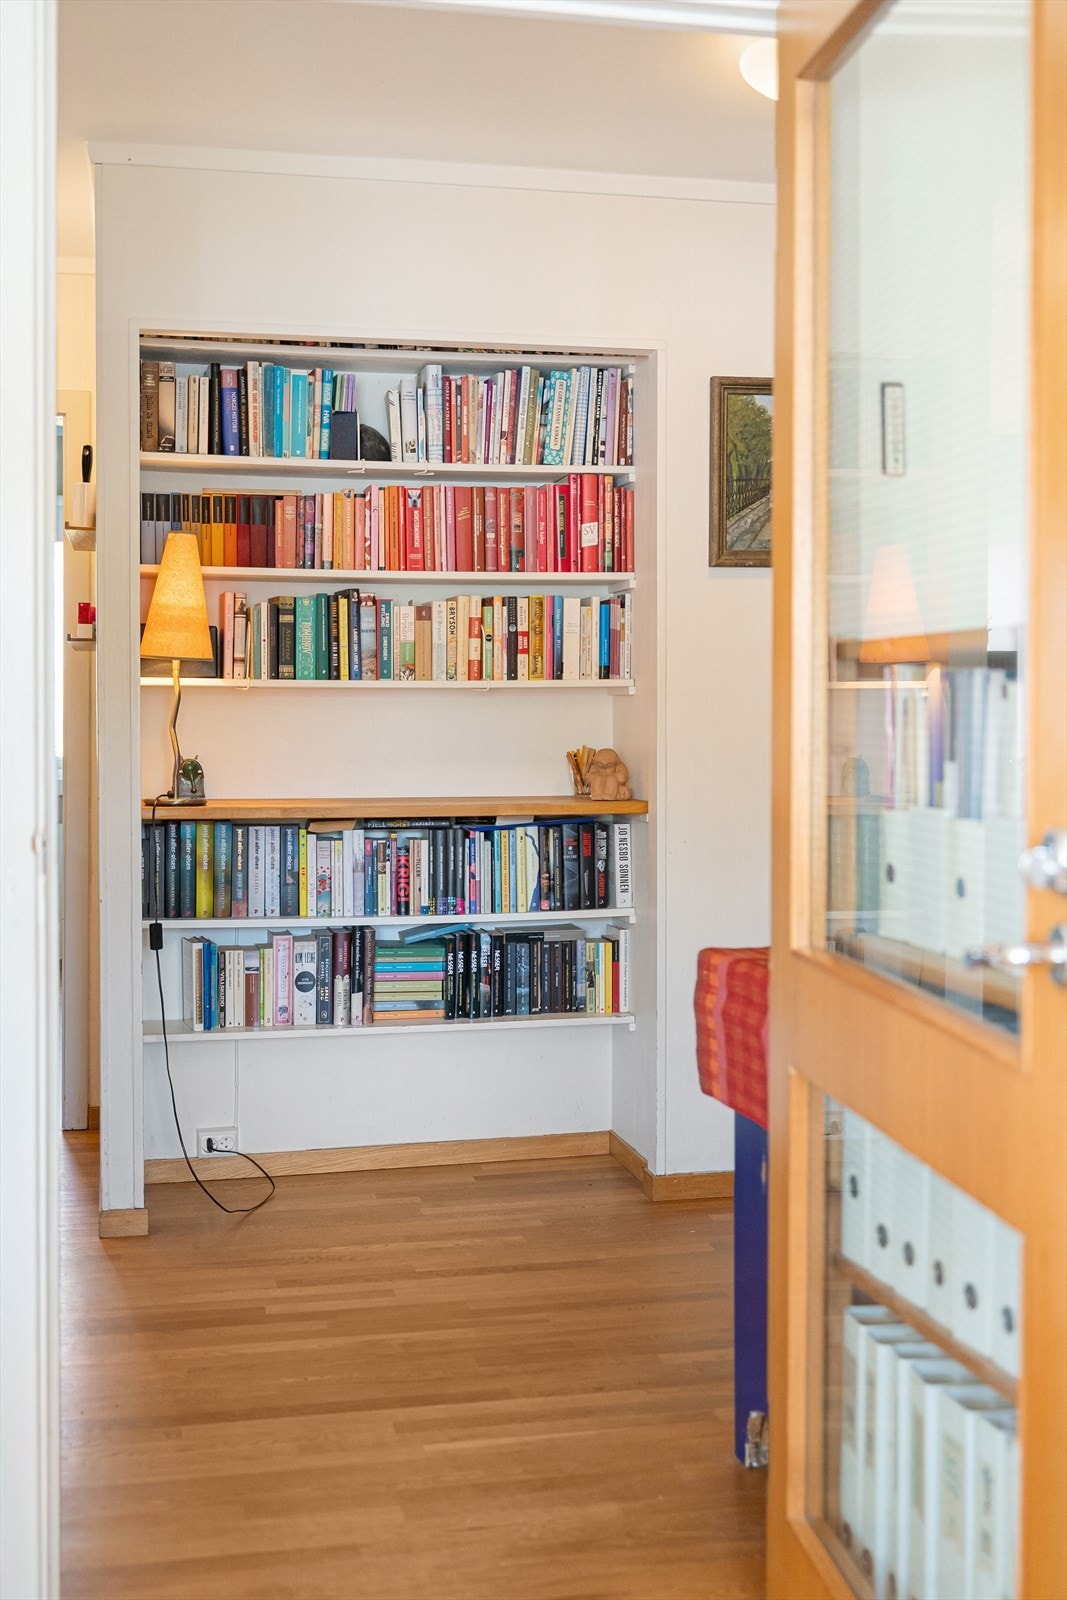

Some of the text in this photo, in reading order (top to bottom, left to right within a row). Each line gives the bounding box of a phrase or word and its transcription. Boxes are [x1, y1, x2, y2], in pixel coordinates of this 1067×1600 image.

[397, 856, 409, 902] KRIG!
[618, 826, 629, 893] JO NESBØ SØNNEN
